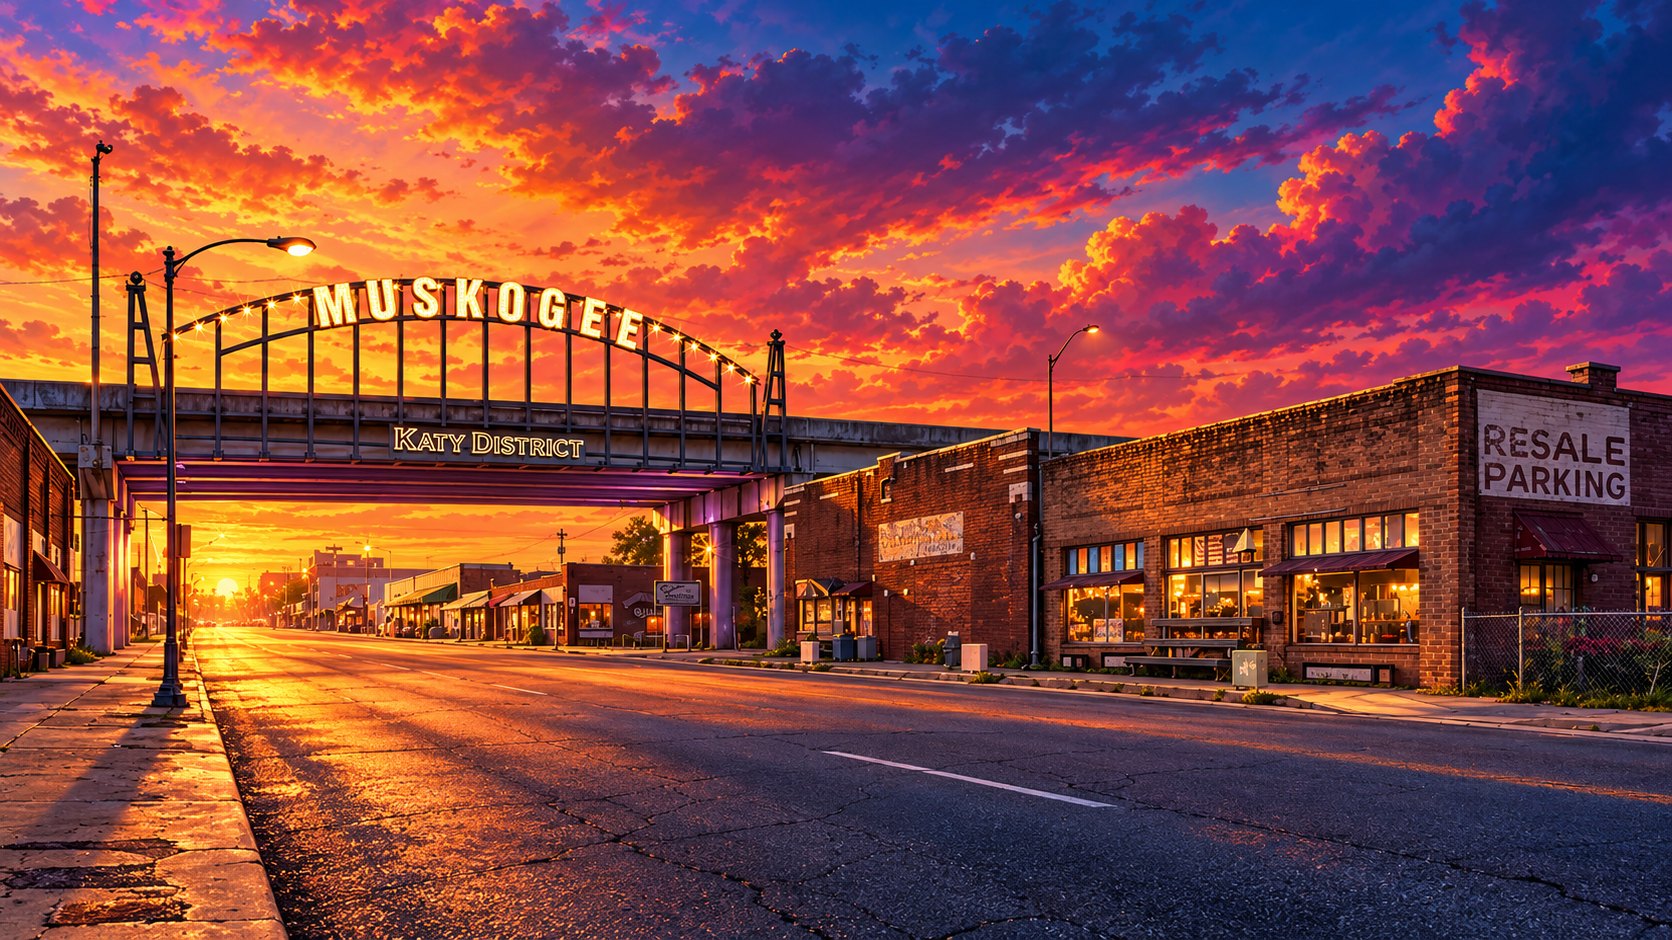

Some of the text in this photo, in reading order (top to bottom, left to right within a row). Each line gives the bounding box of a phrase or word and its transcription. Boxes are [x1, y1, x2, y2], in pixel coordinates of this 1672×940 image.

[312, 276, 644, 350] MUSKOGEE
[1484, 424, 1626, 467] RESALE
[1484, 462, 1626, 500] PARKING
